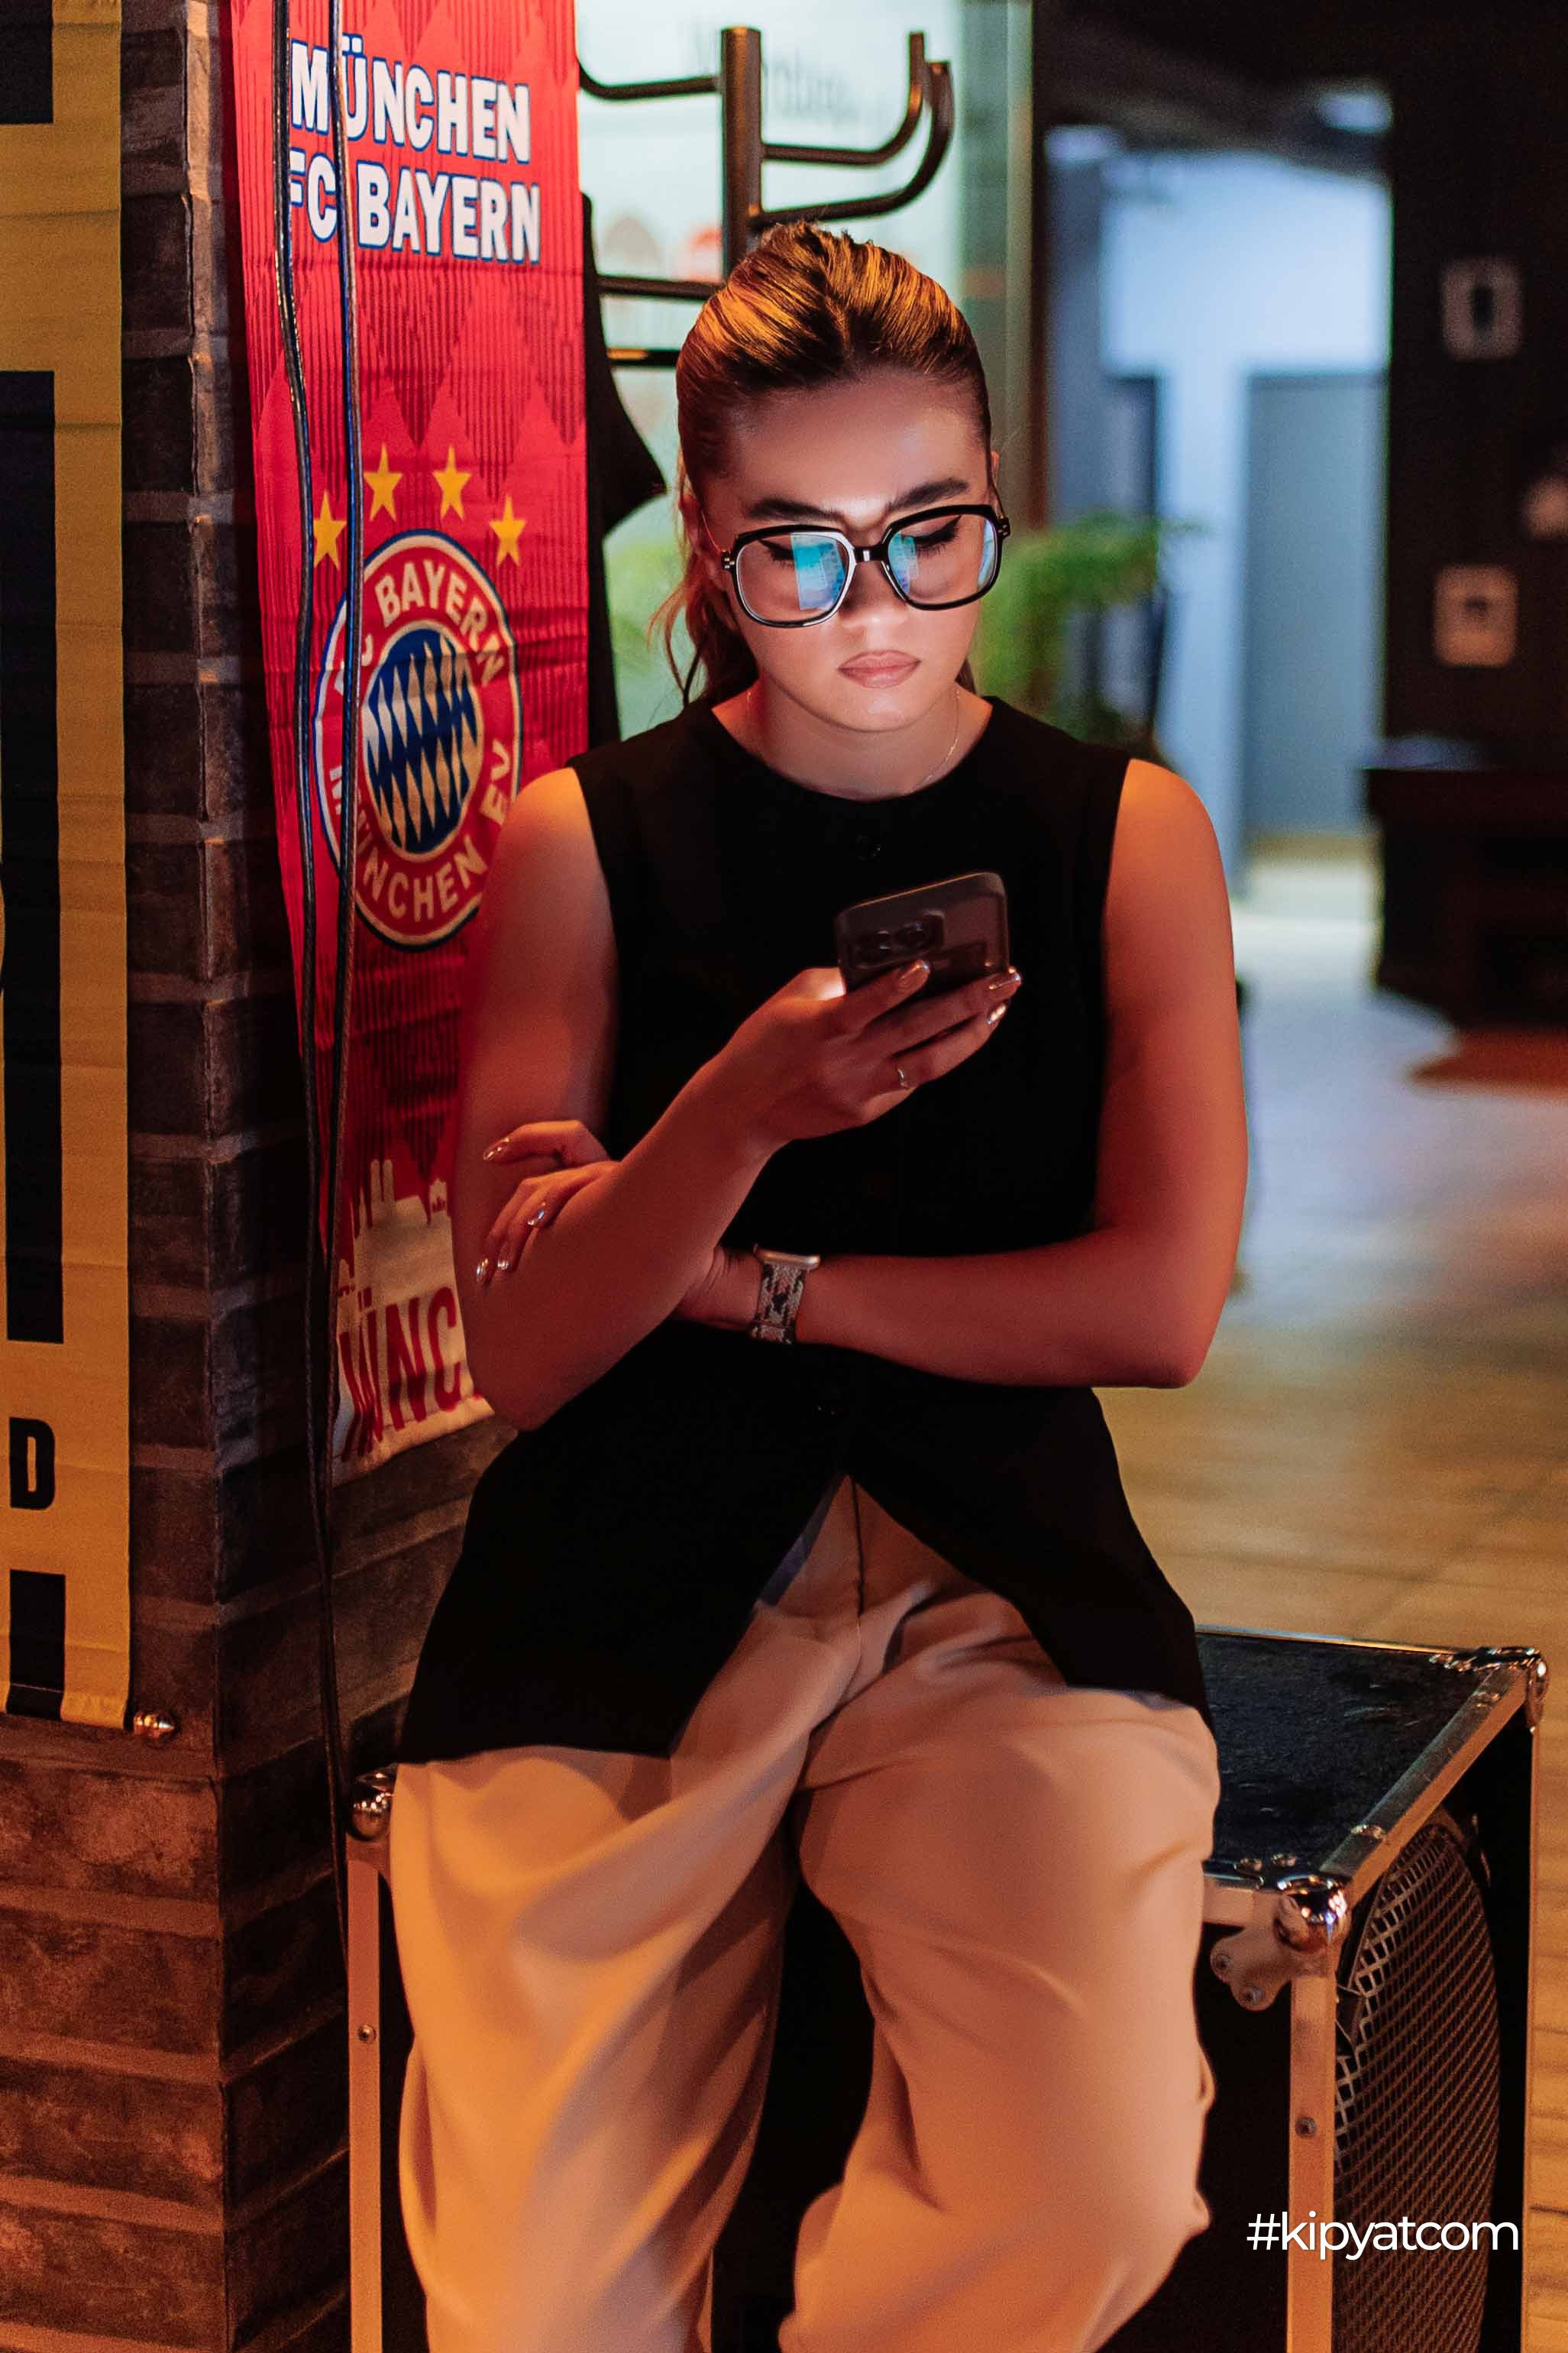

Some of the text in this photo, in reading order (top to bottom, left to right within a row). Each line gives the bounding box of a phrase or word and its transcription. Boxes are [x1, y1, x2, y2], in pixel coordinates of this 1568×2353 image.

[291, 31, 530, 164] MÜNCHEN
[357, 160, 540, 264] BAYERN
[375, 558, 505, 687] BAYERN
